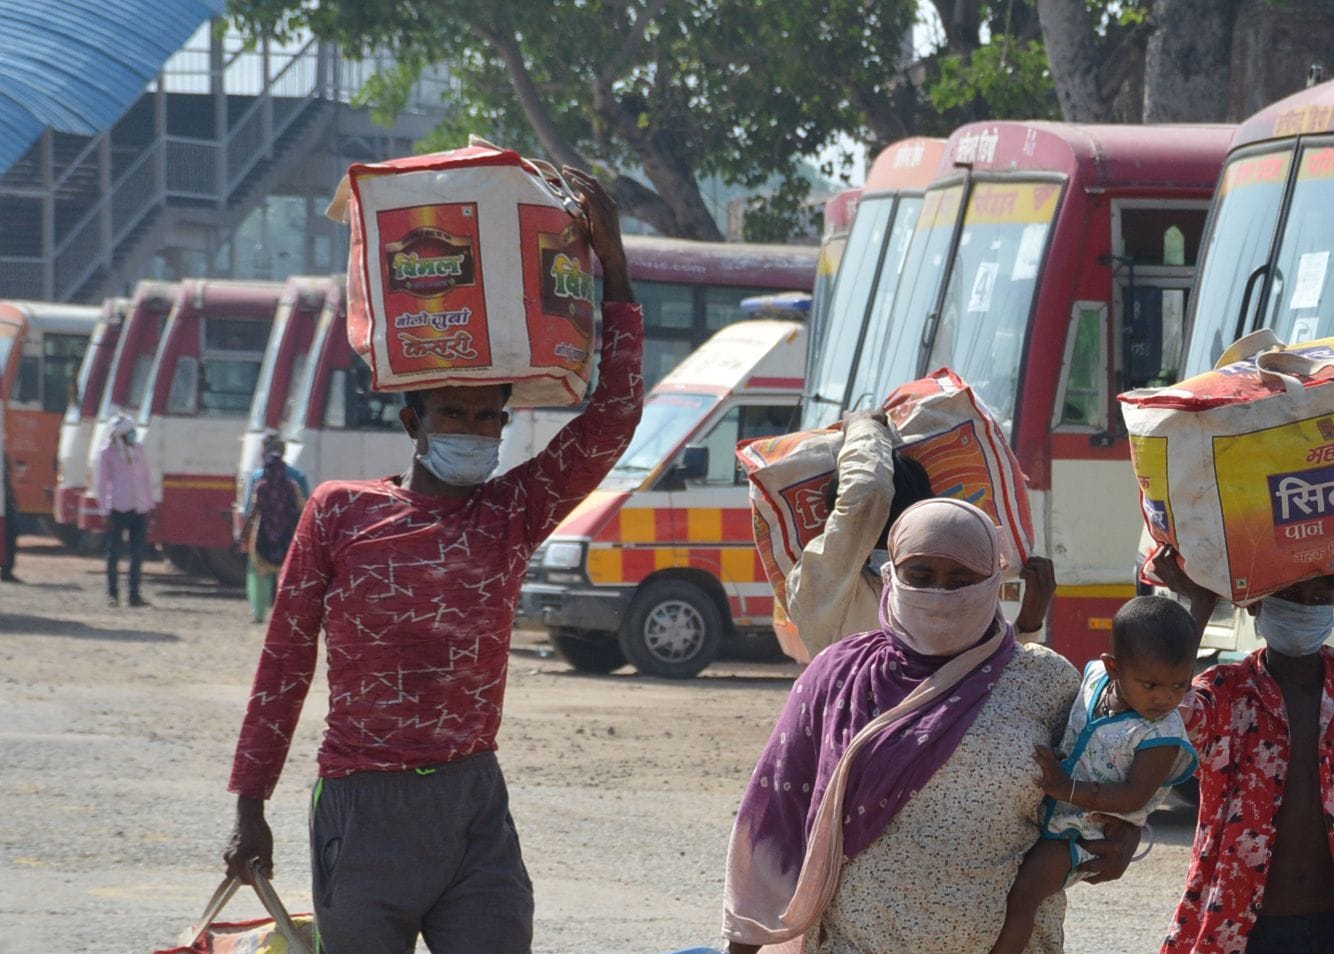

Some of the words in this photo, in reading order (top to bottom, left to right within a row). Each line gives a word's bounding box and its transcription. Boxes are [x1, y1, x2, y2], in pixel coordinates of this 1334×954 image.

[393, 252, 465, 280] विमल
[395, 311, 429, 329] बोलो
[397, 330, 478, 360] केसरी
[1284, 519, 1324, 540] पान
